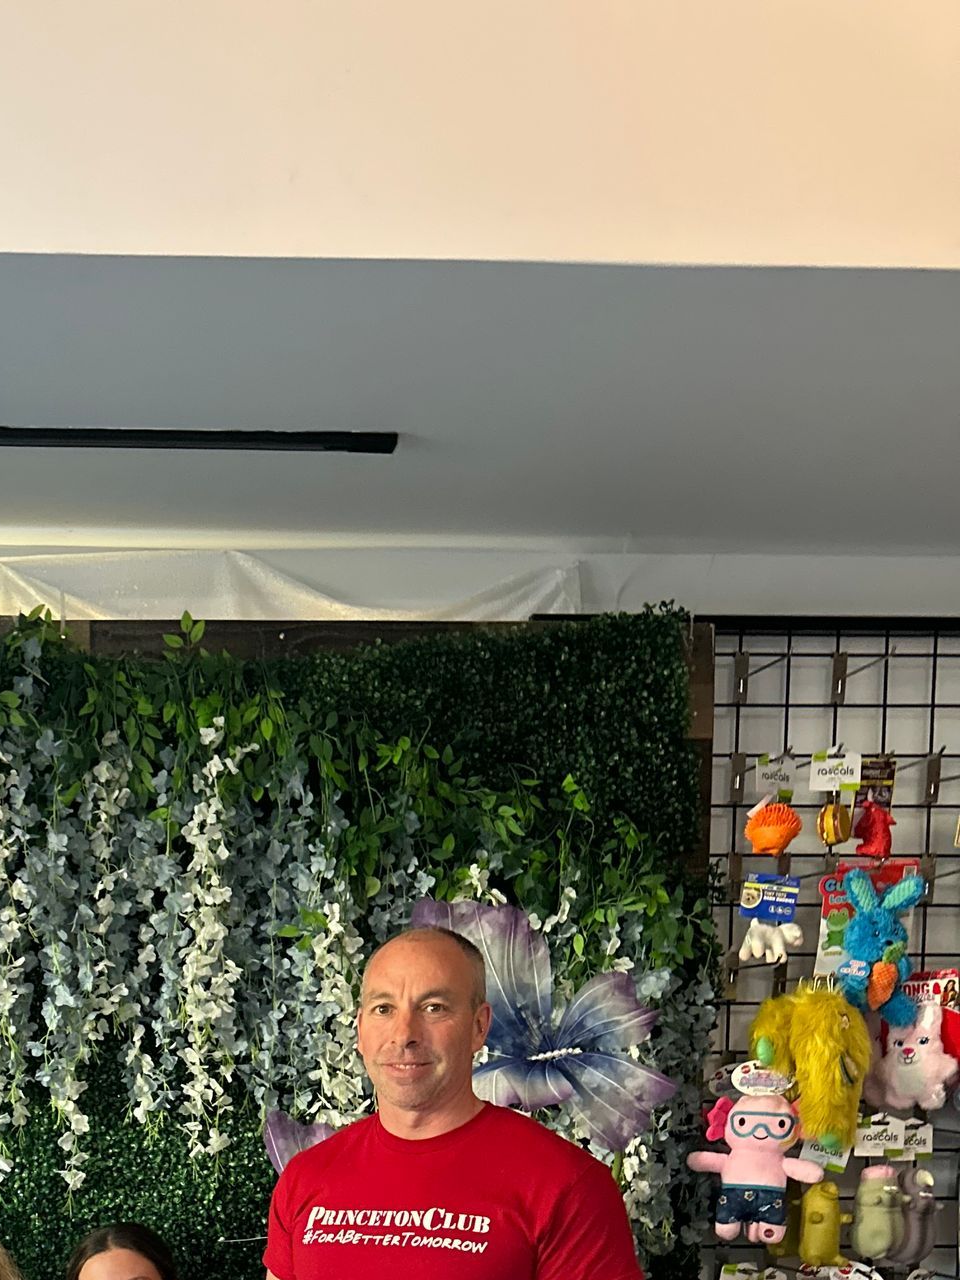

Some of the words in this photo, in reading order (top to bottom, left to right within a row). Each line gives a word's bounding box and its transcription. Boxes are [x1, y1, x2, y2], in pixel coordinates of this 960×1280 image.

[818, 767, 854, 776] rascals
[903, 982, 930, 997] ONG
[862, 1132, 899, 1142] rascals
